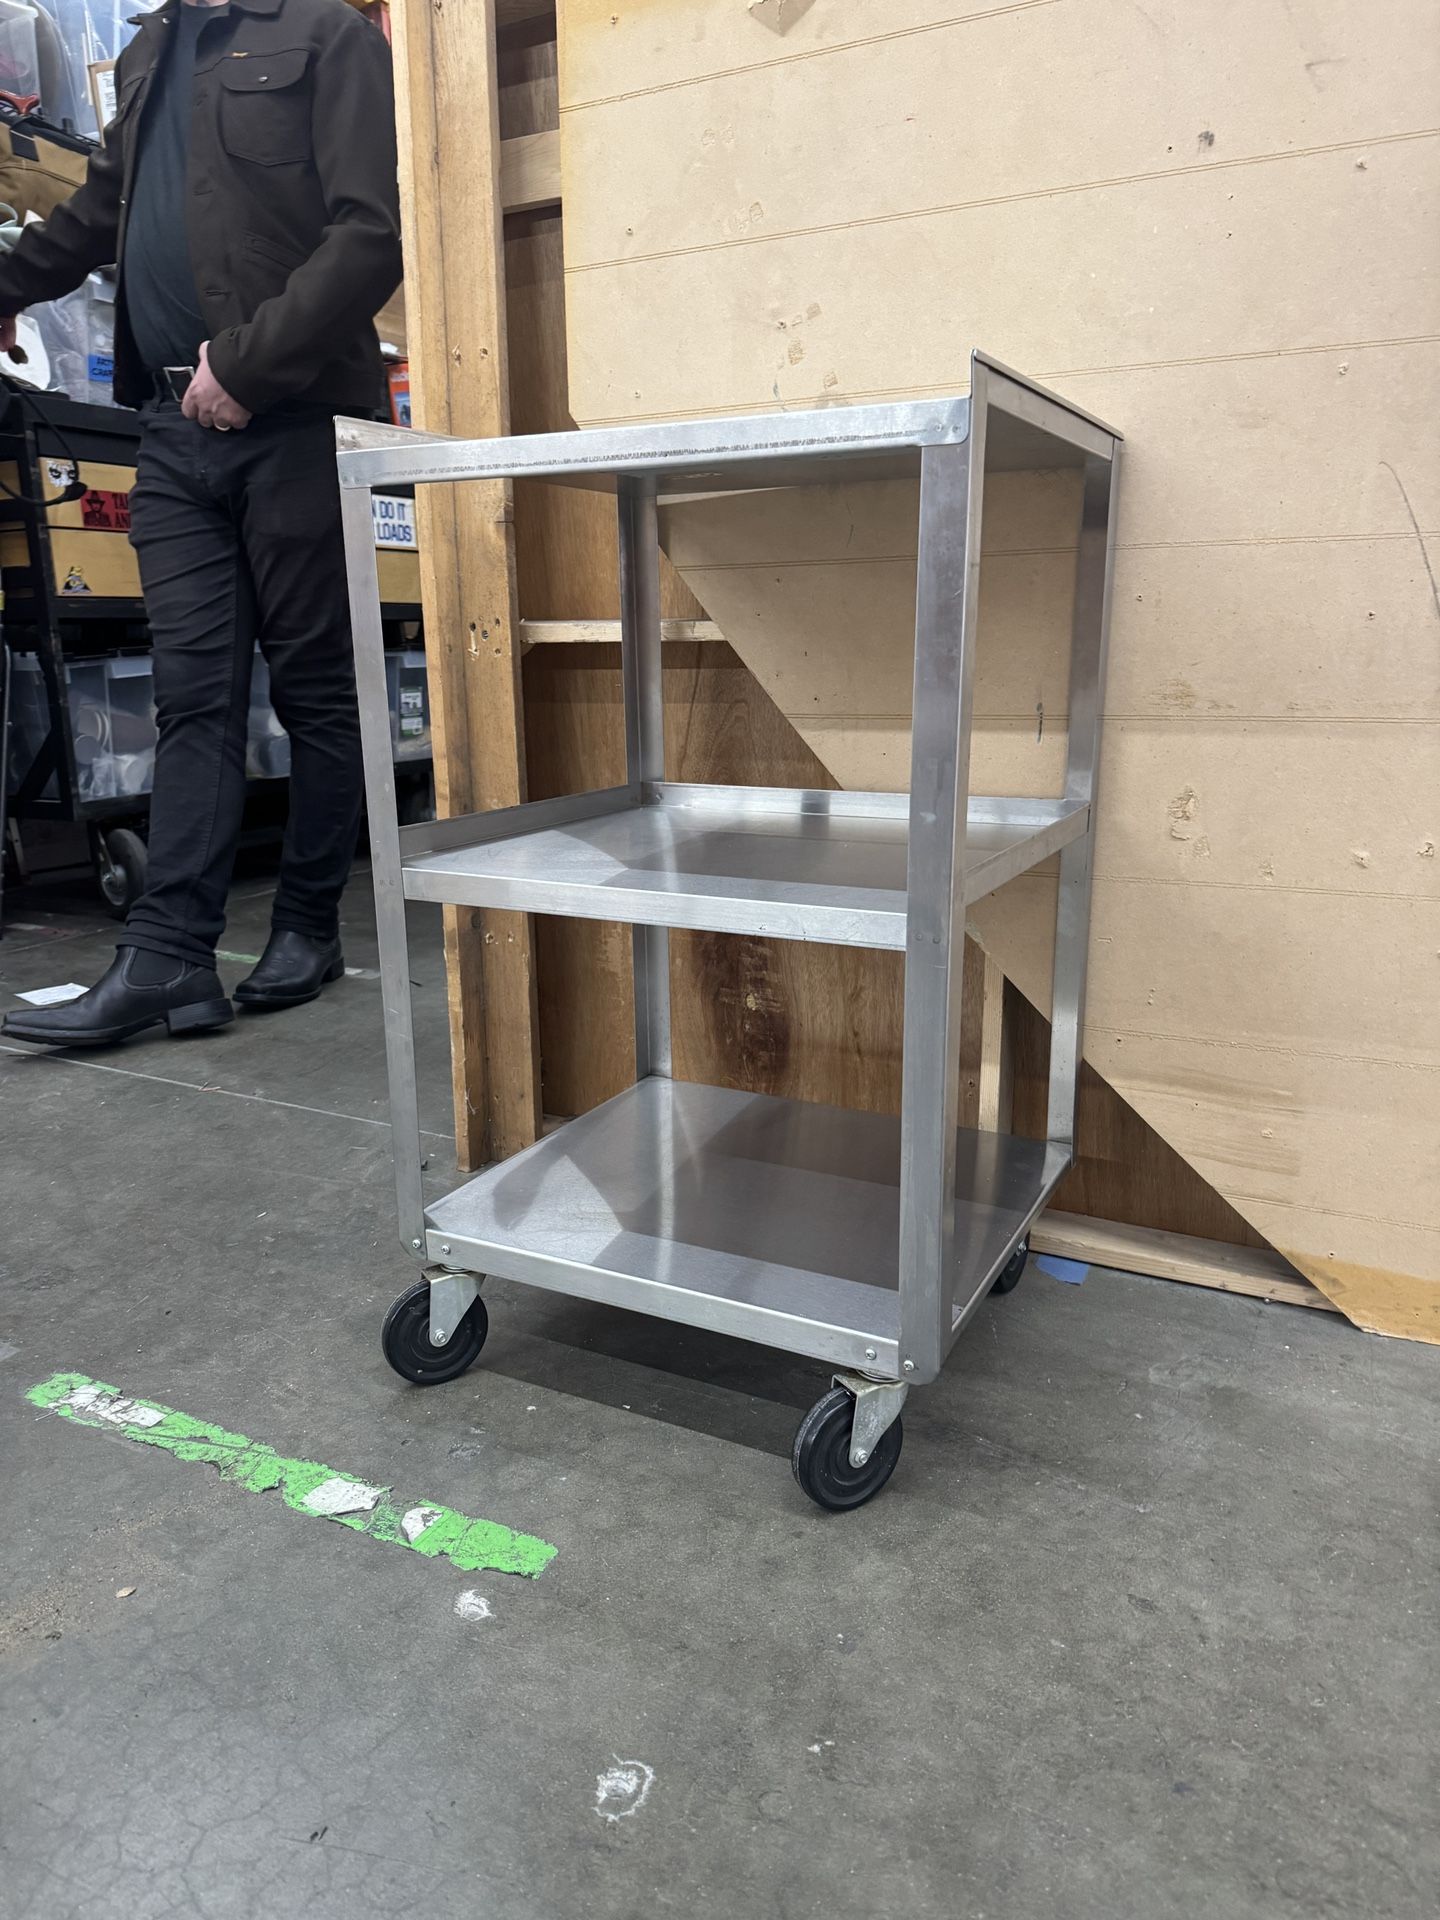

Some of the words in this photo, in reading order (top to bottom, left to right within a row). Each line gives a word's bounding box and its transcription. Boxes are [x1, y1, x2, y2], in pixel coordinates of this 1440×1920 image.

[379, 500, 395, 519] DO
[397, 502, 406, 521] IT
[377, 521, 412, 542] LOADS
